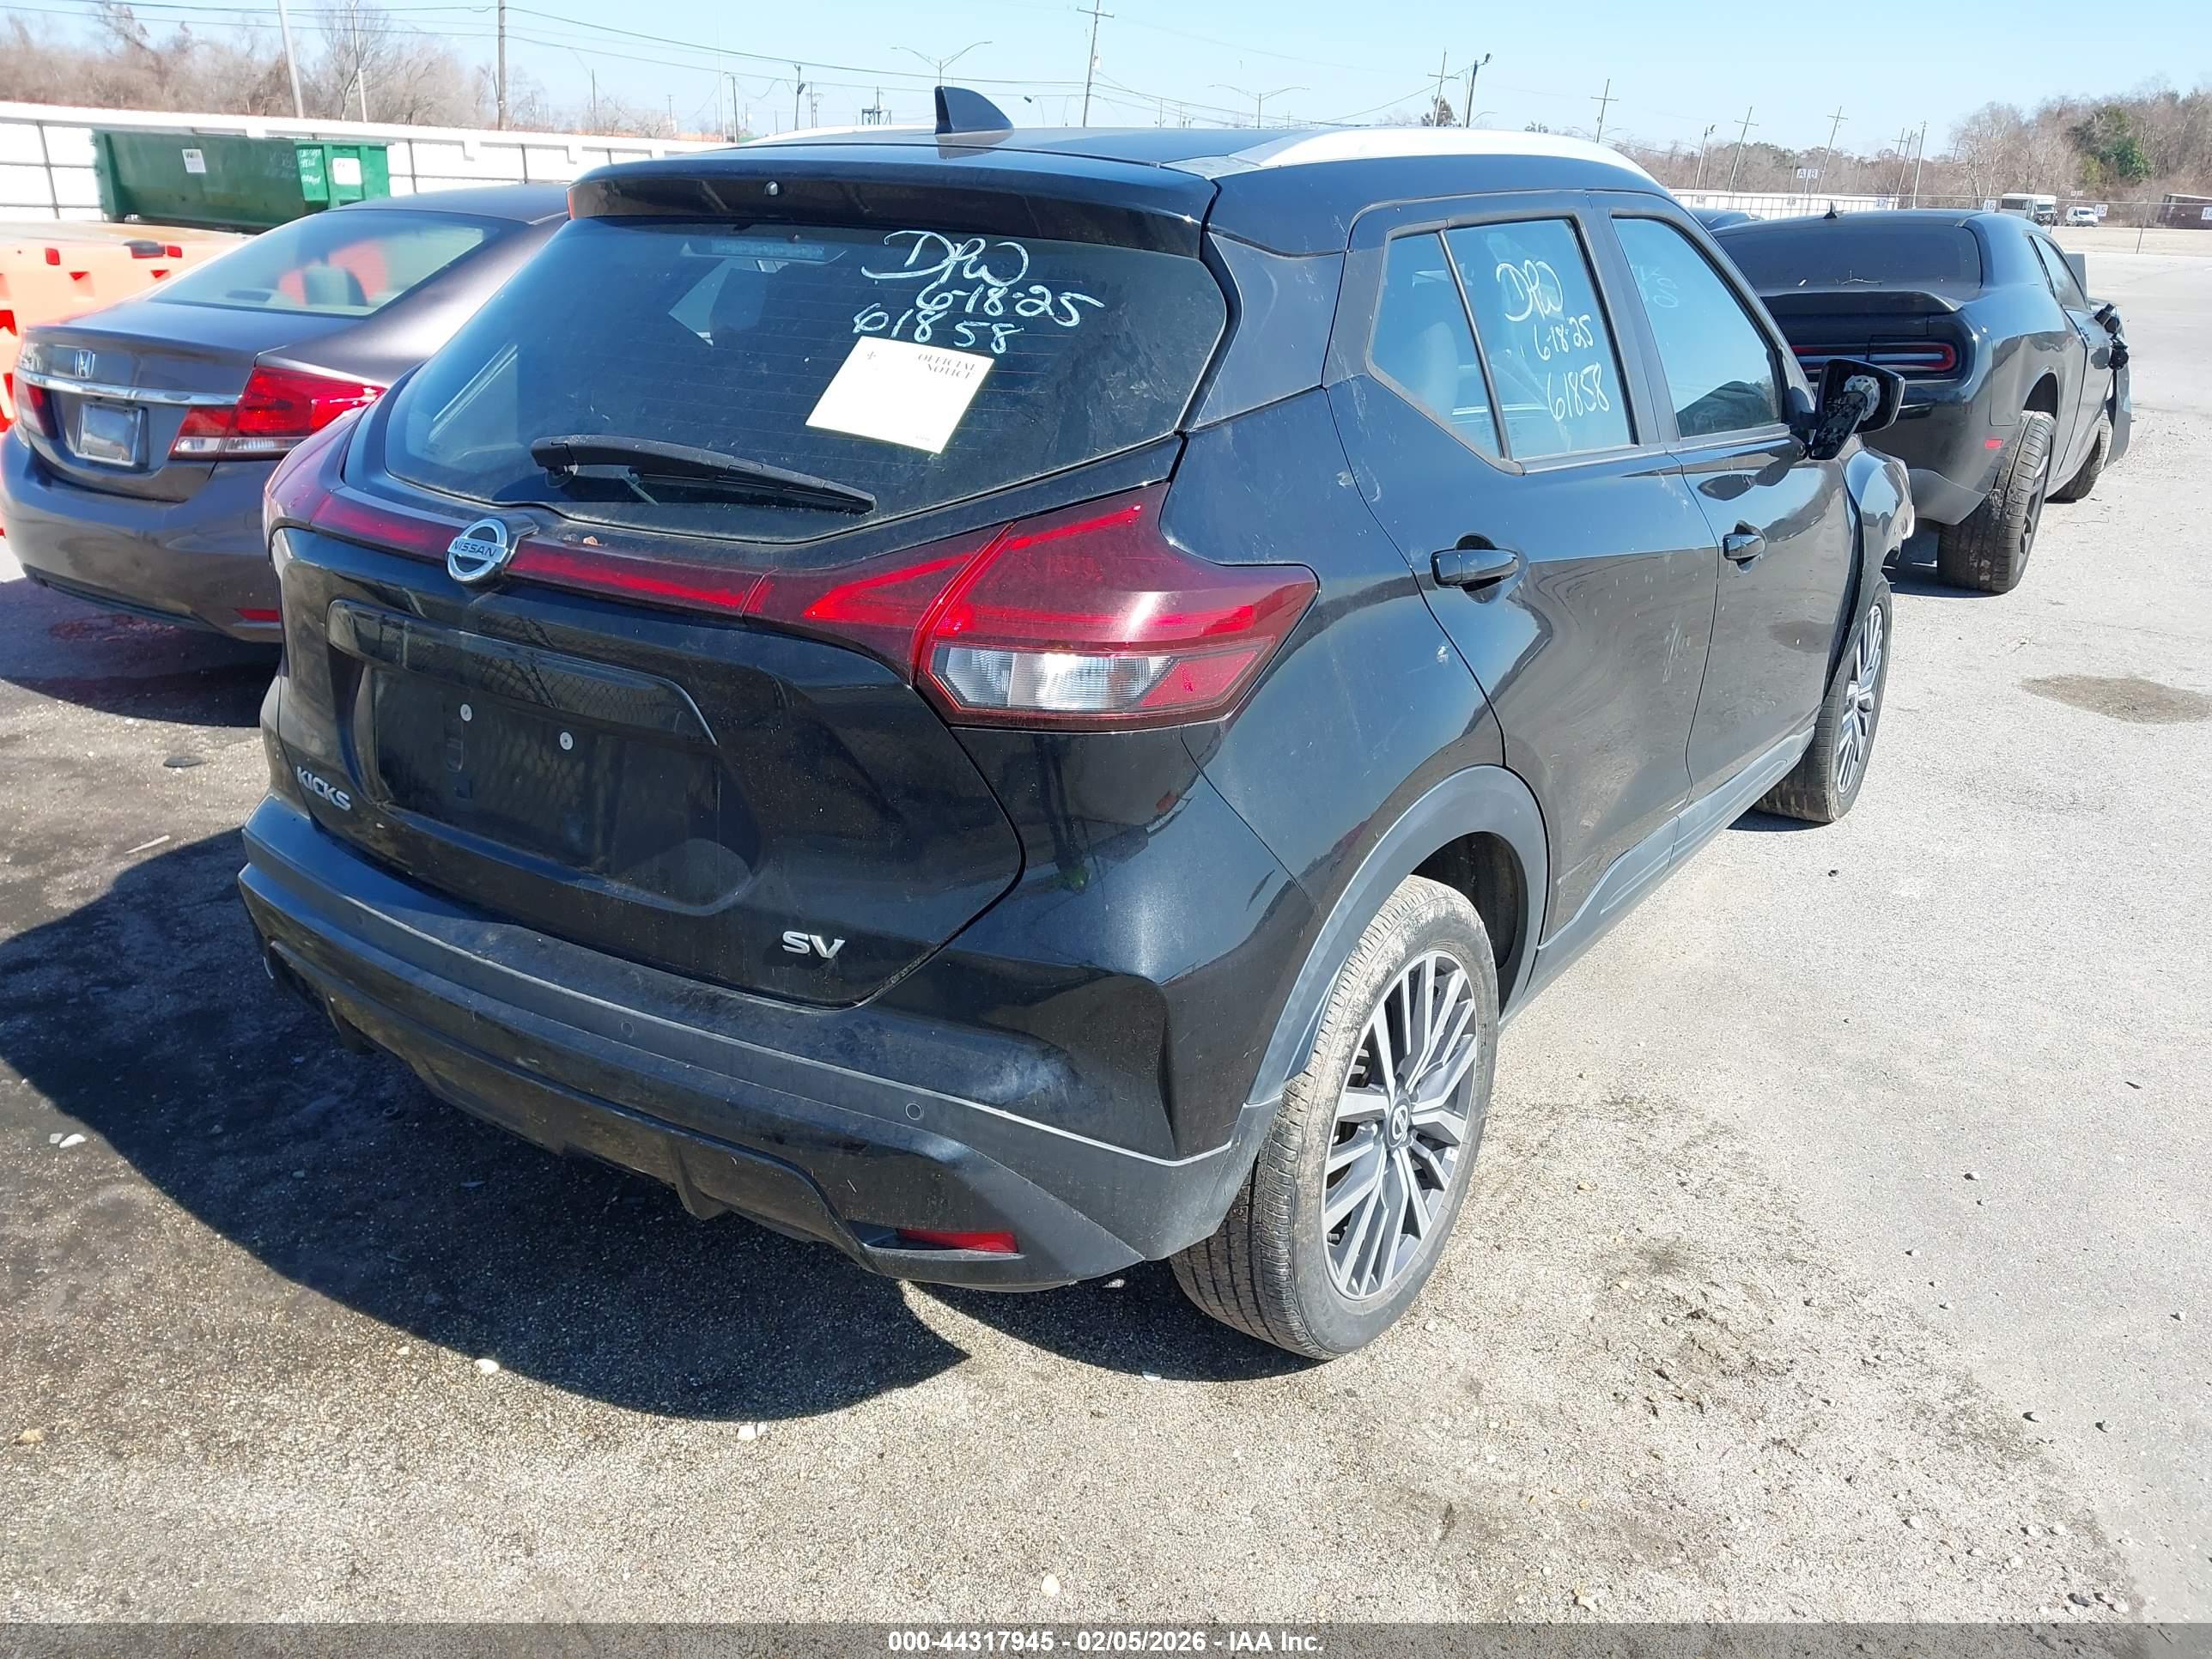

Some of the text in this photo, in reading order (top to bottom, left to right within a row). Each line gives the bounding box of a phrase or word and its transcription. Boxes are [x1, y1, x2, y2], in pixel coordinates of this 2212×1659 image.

[1985, 202, 1995, 210] 16
[2096, 206, 2106, 215] 15
[917, 353, 975, 371] OFFICIAL
[927, 363, 972, 380] NOTICE
[1547, 362, 1610, 422] 61858
[453, 541, 496, 557] NISSAN
[296, 766, 351, 811] KICKS
[782, 931, 846, 959] SV
